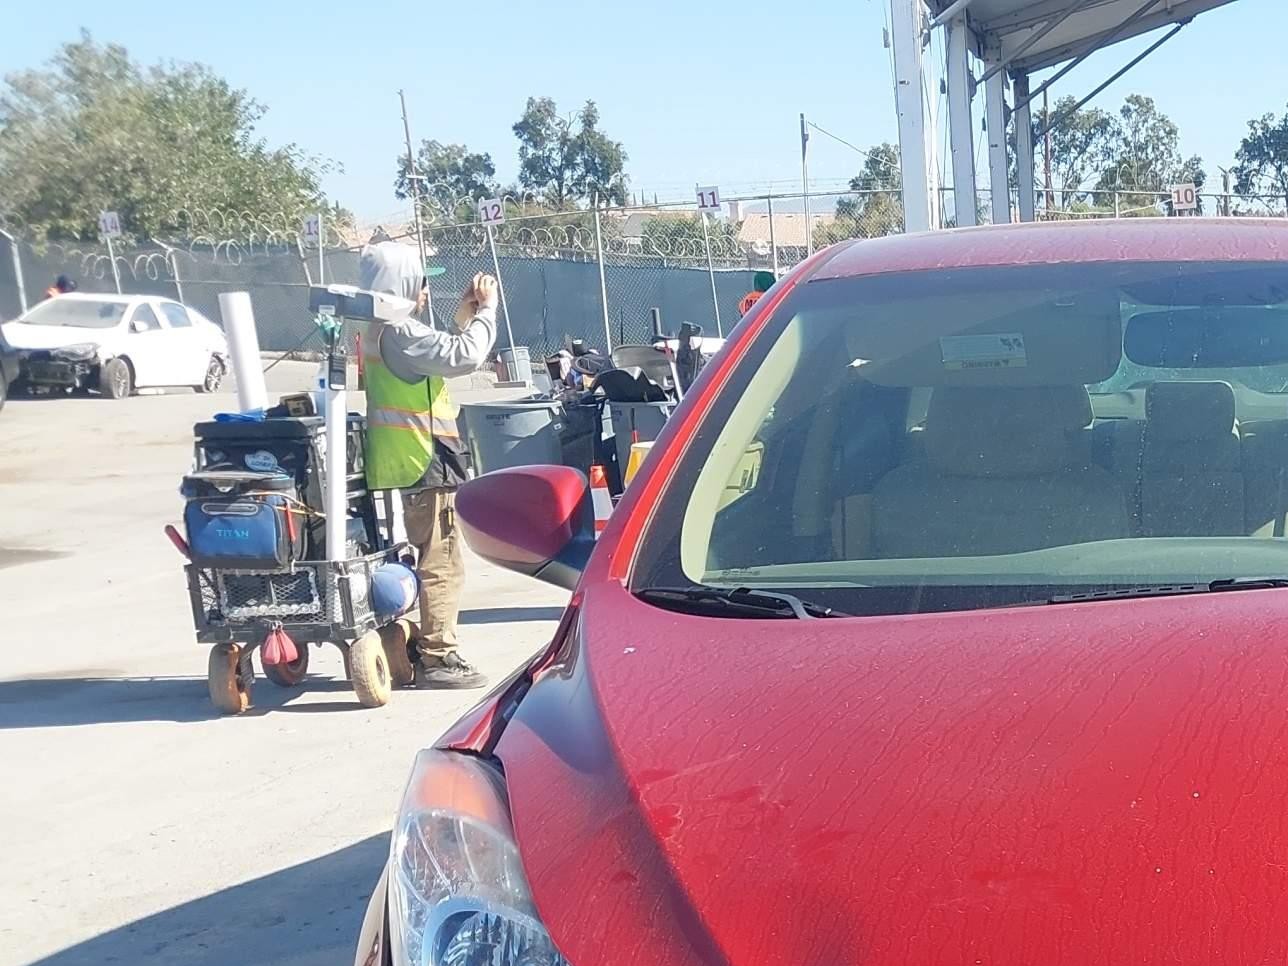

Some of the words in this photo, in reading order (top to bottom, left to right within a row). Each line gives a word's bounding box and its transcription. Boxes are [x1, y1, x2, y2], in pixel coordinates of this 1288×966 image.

[699, 191, 719, 209] 11
[1173, 188, 1193, 205] 10
[481, 203, 502, 222] 12
[101, 217, 118, 233] 14
[215, 529, 249, 538] TITAN
